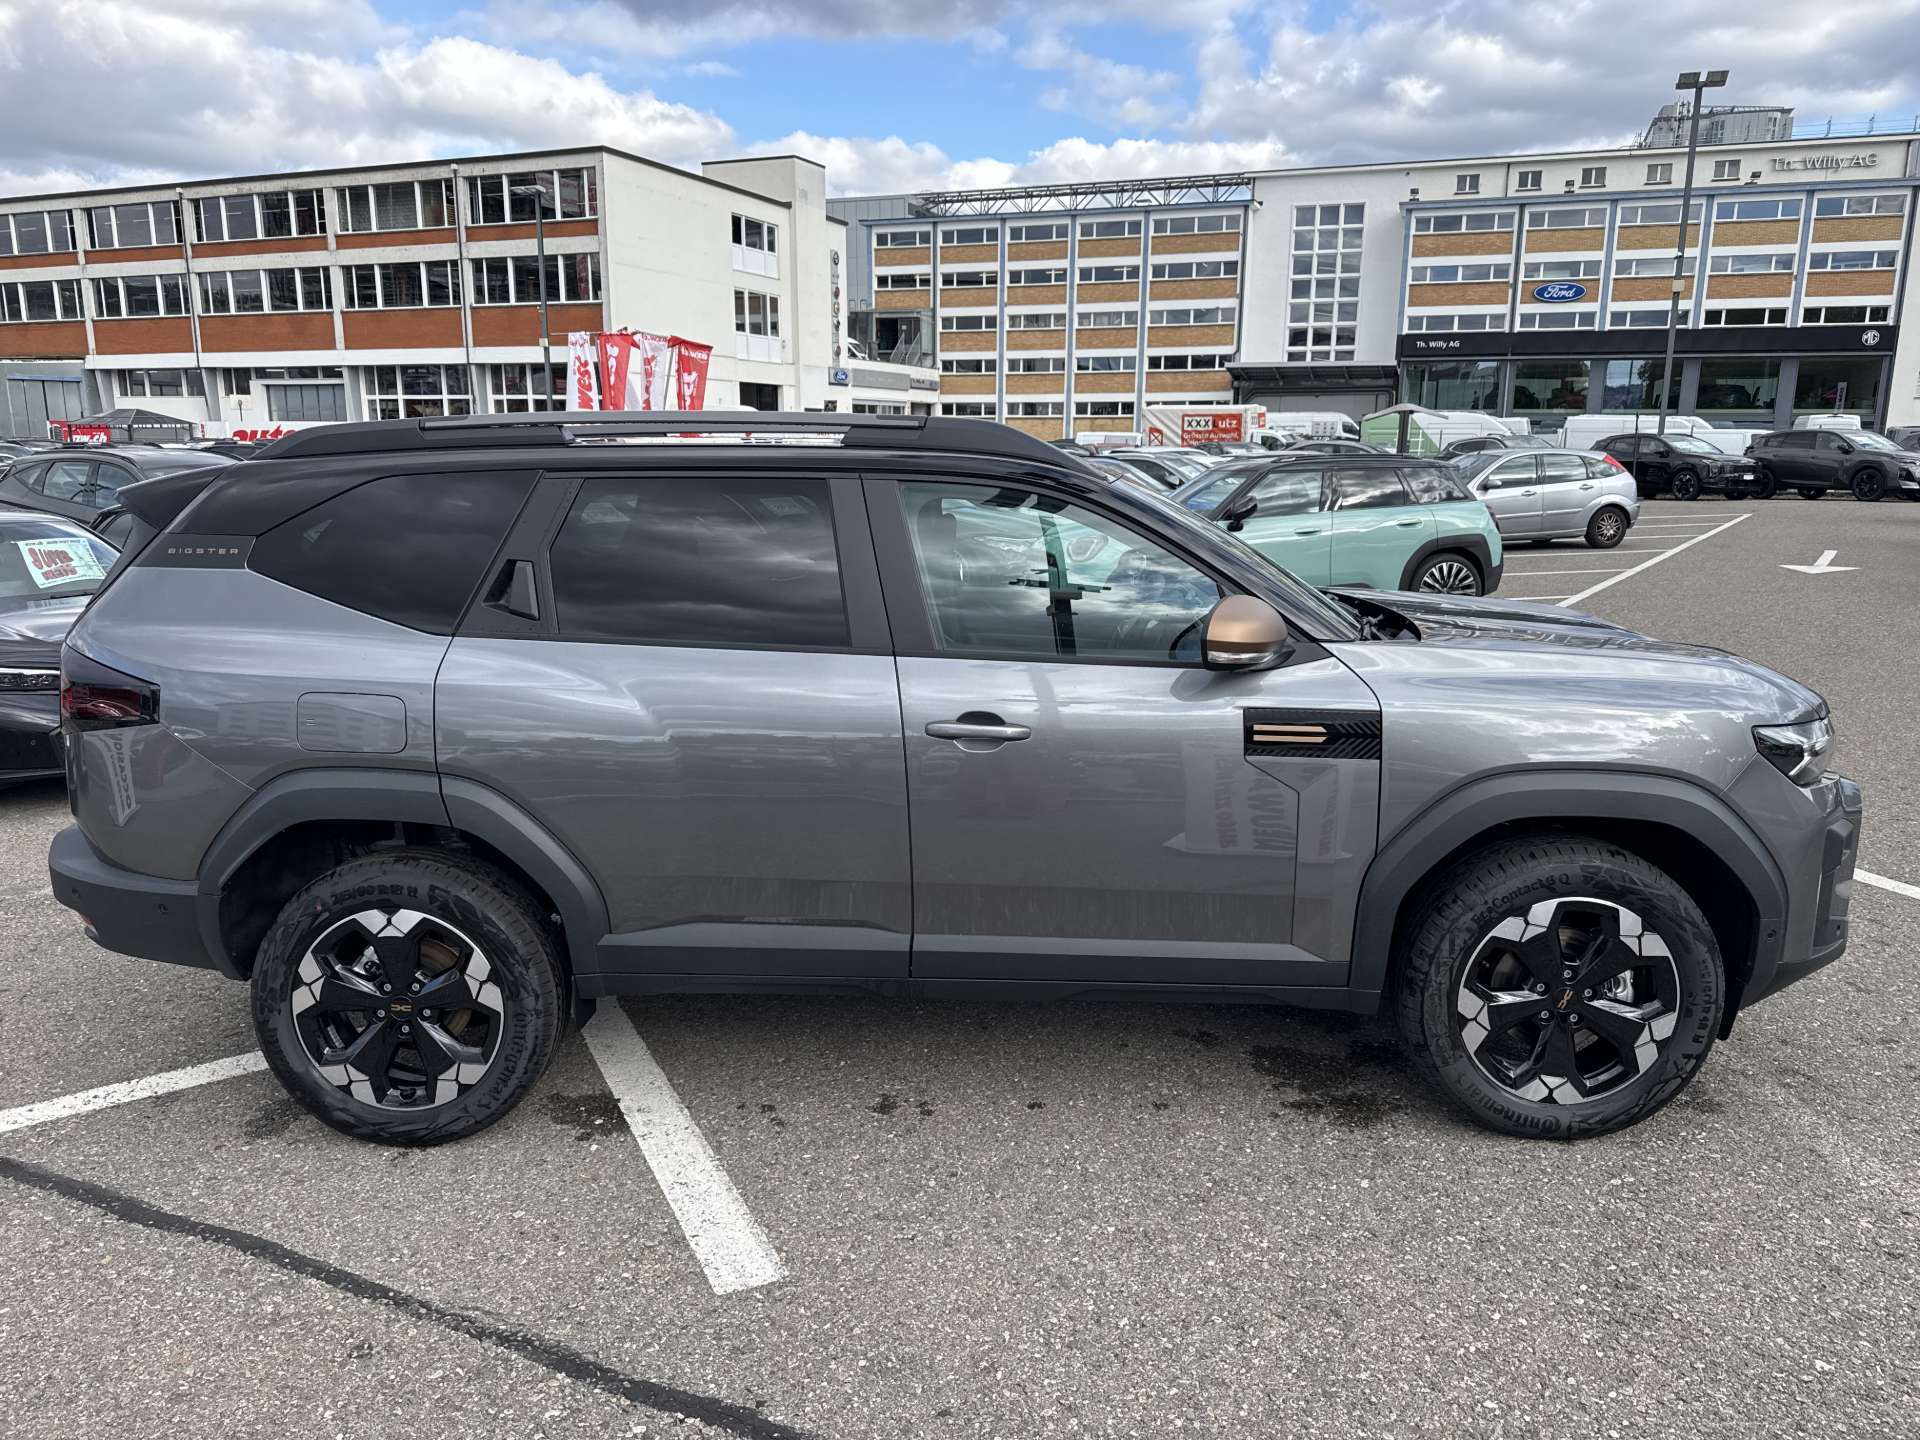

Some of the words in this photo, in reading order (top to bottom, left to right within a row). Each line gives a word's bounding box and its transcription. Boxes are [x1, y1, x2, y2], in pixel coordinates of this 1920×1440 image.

[1805, 153, 1847, 170] Willy
[1850, 153, 1878, 168] AG
[1862, 330, 1880, 346] MG
[1416, 340, 1428, 349] Th.
[1429, 340, 1447, 350] Willy
[1448, 340, 1460, 348] AG
[168, 547, 239, 555] BIGSTER
